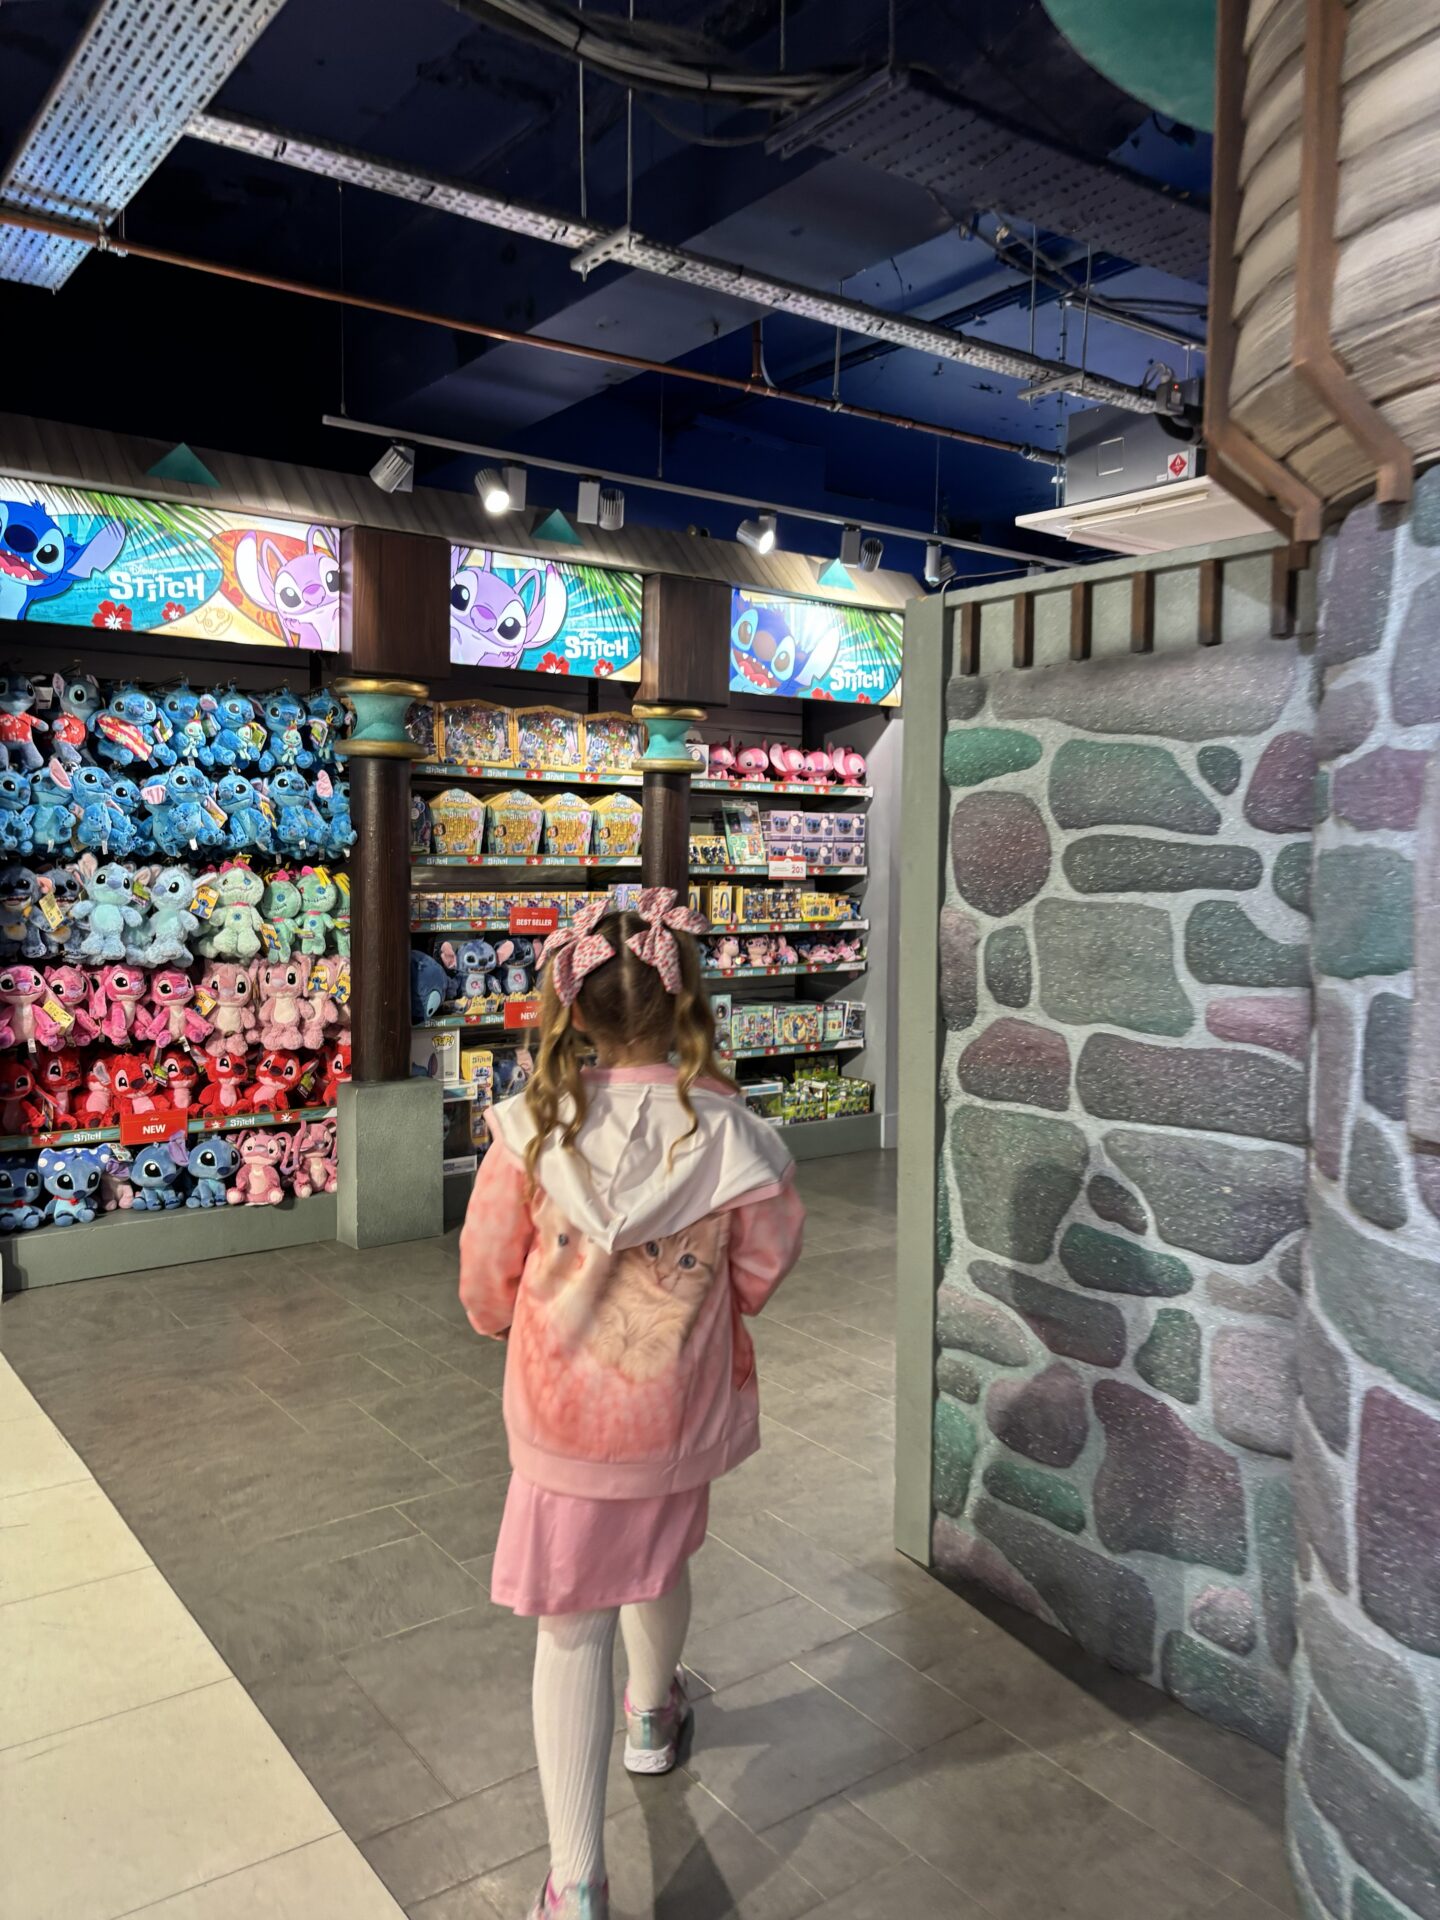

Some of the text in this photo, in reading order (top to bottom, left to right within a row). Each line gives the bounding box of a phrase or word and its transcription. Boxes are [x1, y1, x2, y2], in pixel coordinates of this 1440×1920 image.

[516, 918, 531, 926] BEST
[531, 918, 552, 926] SELLER
[142, 1124, 166, 1135] NEW
